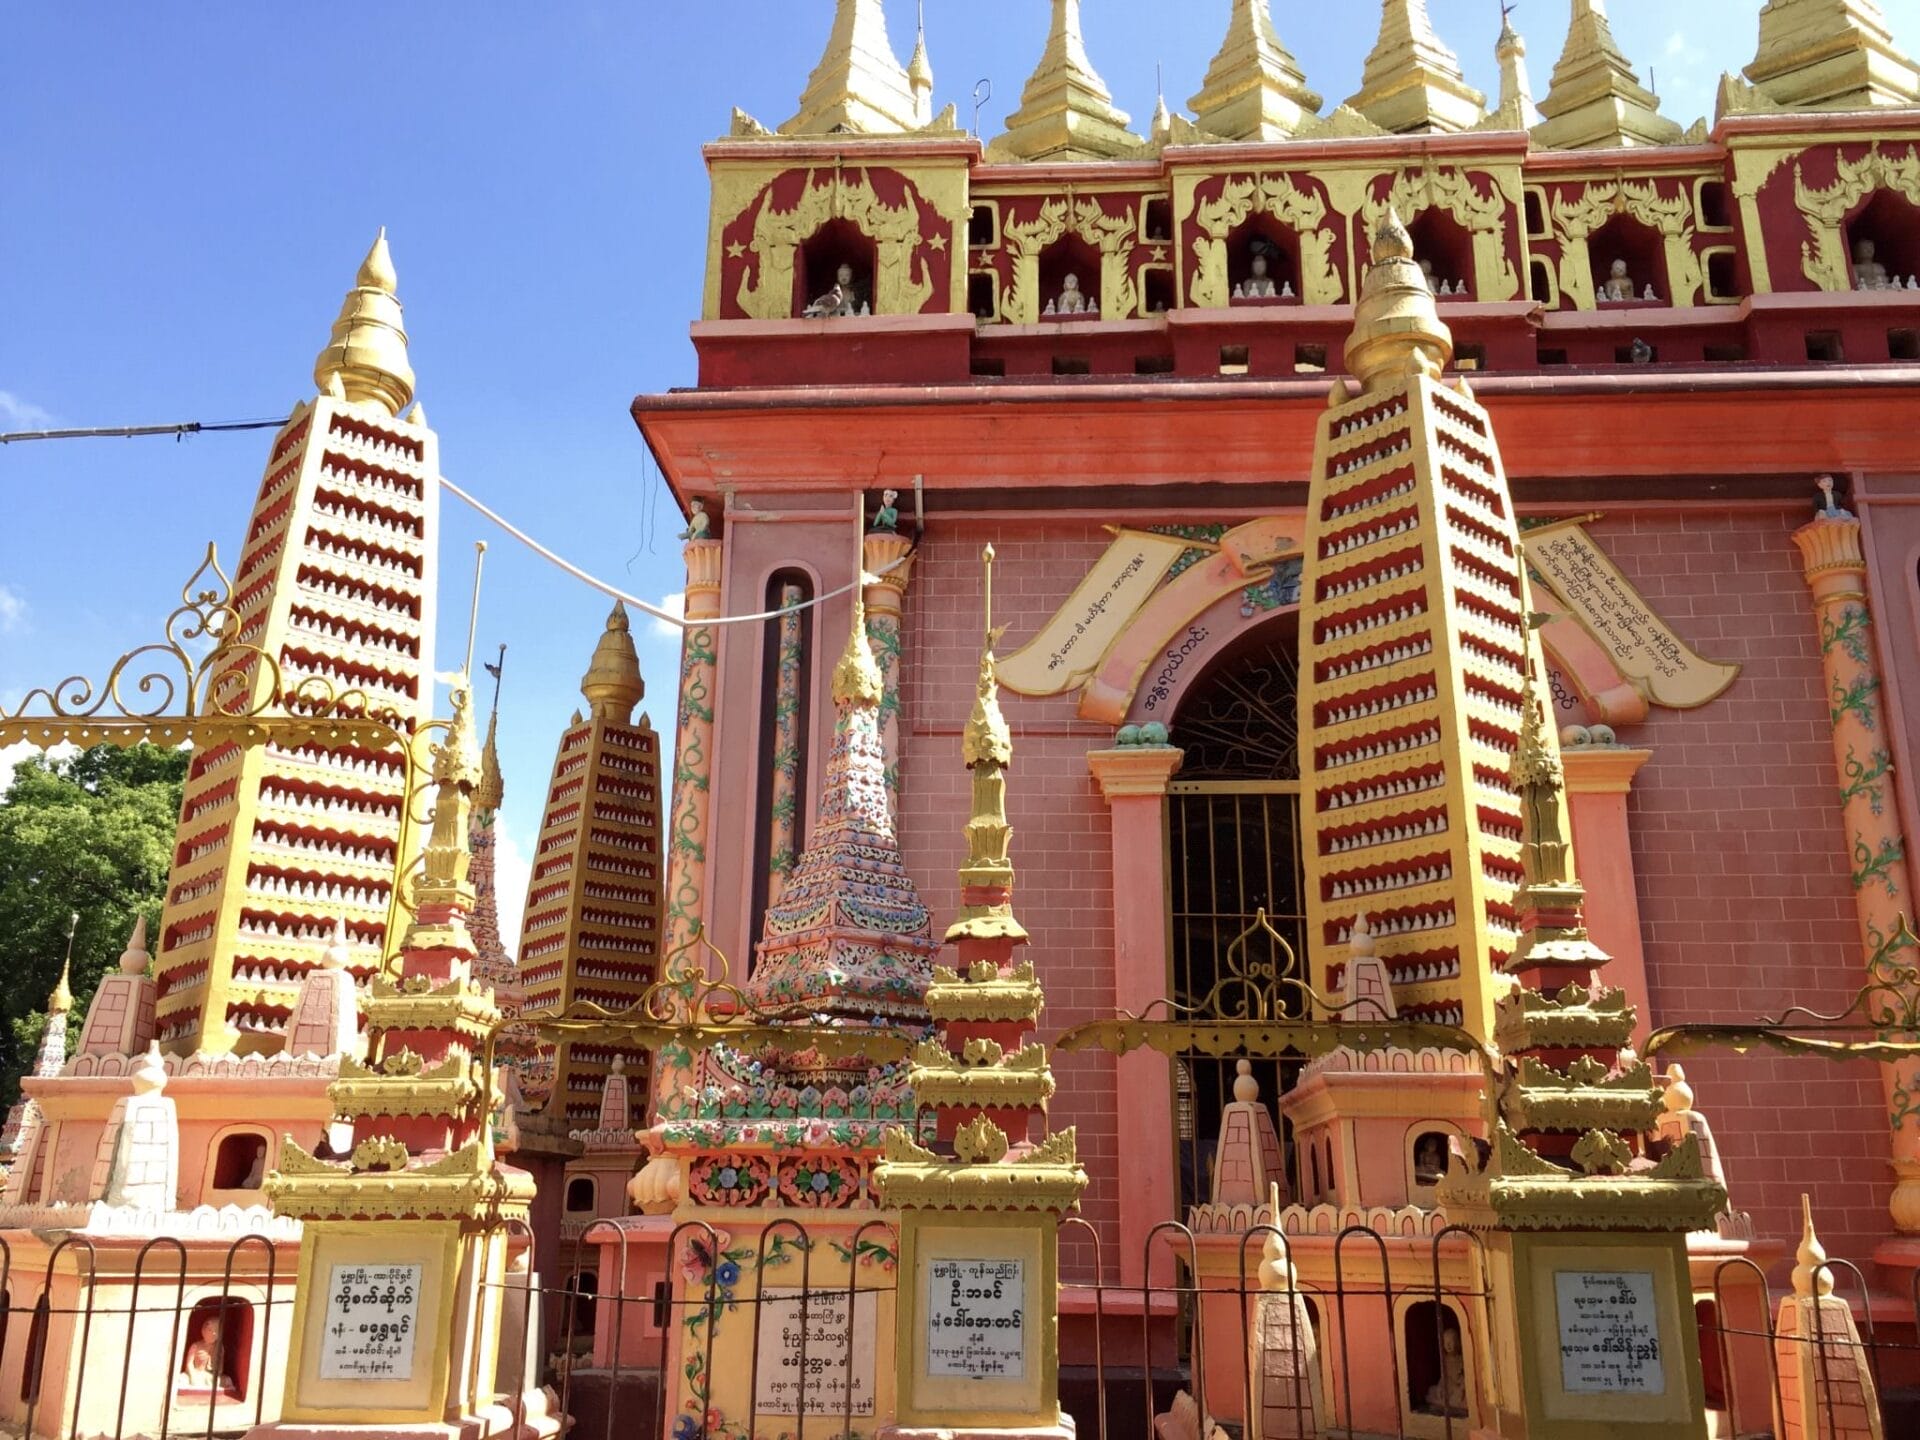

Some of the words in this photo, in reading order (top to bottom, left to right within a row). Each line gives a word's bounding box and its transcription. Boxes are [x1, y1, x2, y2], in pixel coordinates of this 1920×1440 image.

[1144, 626, 1210, 711] အန္တရာယ်ကင်း
[335, 1285, 414, 1314] ကိုစက်ဆိုက်
[951, 1280, 1003, 1307] ဦးဘခင်
[943, 1308, 1022, 1328] ဒေါ်အေးတင်
